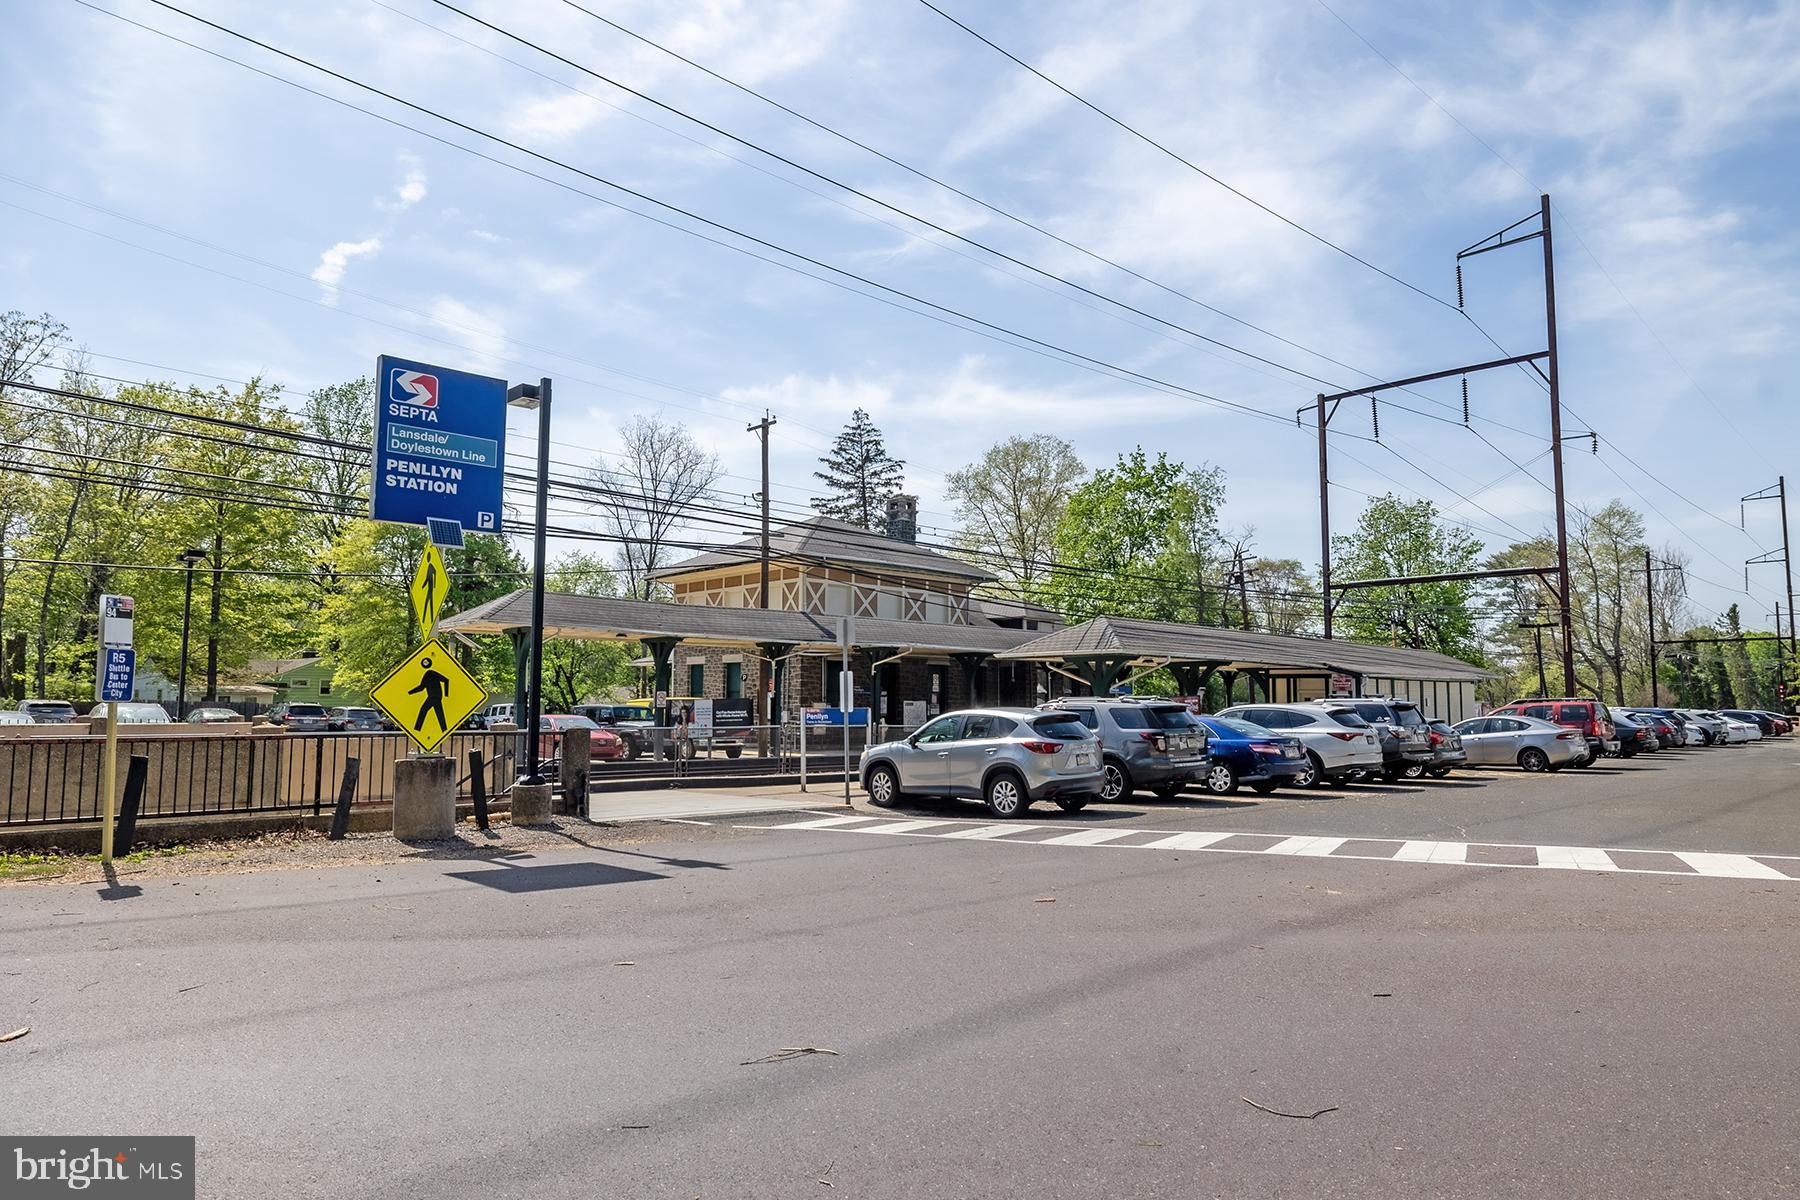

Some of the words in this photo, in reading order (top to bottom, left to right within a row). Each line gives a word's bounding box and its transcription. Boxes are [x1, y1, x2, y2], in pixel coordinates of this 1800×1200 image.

[389, 404, 438, 422] SEPTA
[392, 426, 448, 444] Lansdale/
[391, 439, 459, 458] Doylestown
[462, 449, 485, 462] Line
[386, 459, 462, 480] PENLLYN
[386, 475, 457, 494] STATION
[480, 513, 492, 527] P
[106, 607, 116, 617] 94
[112, 652, 126, 663] R5
[108, 663, 130, 672] Shuttle
[107, 681, 128, 689] Center
[110, 689, 123, 698] City
